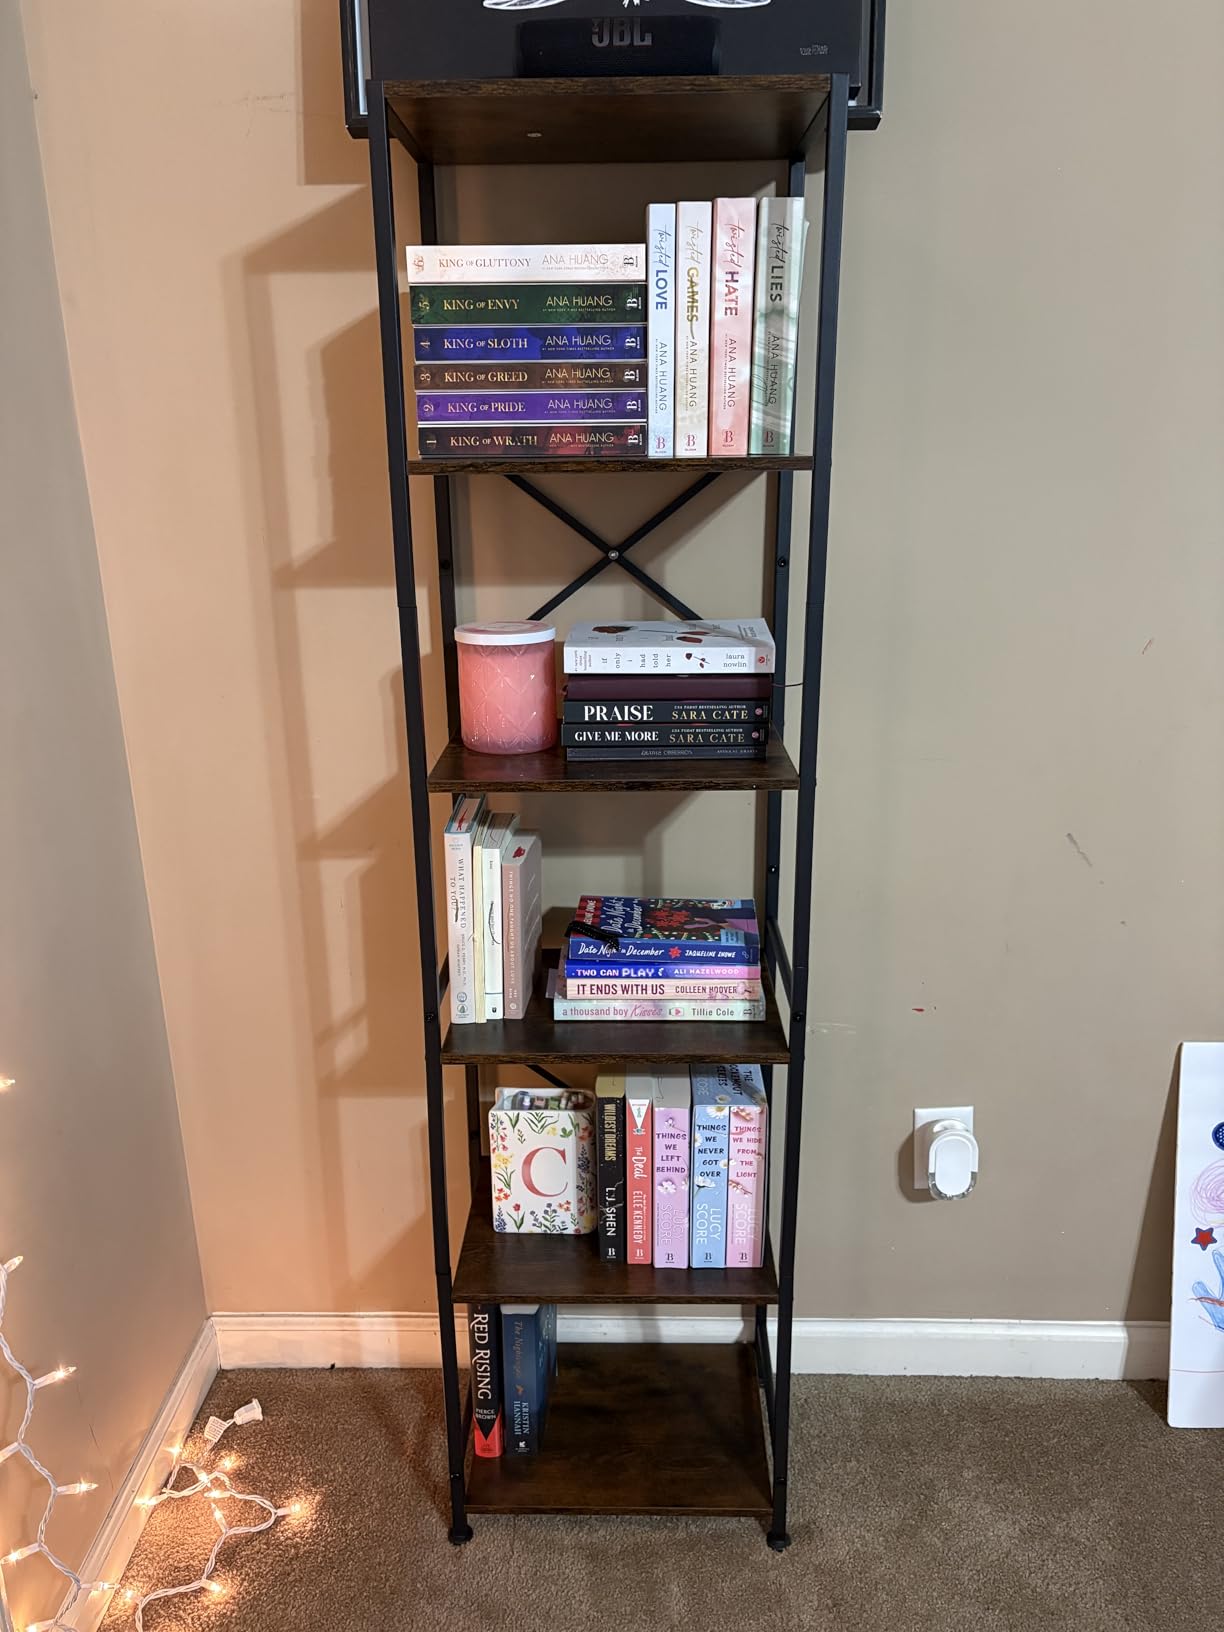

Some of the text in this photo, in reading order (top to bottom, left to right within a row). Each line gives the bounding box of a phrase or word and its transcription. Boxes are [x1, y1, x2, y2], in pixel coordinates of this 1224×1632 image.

[592, 18, 653, 47] JBL
[439, 258, 464, 268] KING
[475, 257, 531, 268] GLUTTONY
[542, 253, 609, 265] ANA HUANG
[769, 219, 790, 303] twisted LIES
[652, 223, 672, 310] twisted LOVE
[723, 219, 745, 316] twisted HATE
[546, 295, 613, 306] ANA HUANG
[686, 267, 699, 322] GAMES
[443, 300, 474, 310] KING
[487, 299, 520, 310] ENVY
[419, 341, 431, 350] 4
[444, 338, 473, 349] KING
[487, 337, 528, 348] SLOTH
[545, 334, 611, 345] ANA HUANG
[769, 335, 780, 360] ANA
[420, 373, 431, 381] 3
[444, 372, 474, 382] KING
[488, 371, 528, 382] GREED
[545, 367, 611, 378] ANA HUANG
[658, 341, 668, 411] ANA HUANG
[688, 340, 698, 408] ANA HUANG
[727, 338, 737, 408] ANA HUANG
[768, 364, 778, 405] HUANG
[423, 404, 434, 412] 2
[447, 402, 477, 413] KING
[491, 401, 526, 412] PRIDE
[547, 398, 613, 409] ANA HUANG
[450, 436, 480, 446] KING
[493, 435, 538, 446] WRATH
[549, 432, 614, 443] ANA HUANG
[614, 652, 622, 669] only
[723, 660, 747, 668] nowlin
[583, 705, 654, 721] PRAISE
[671, 710, 749, 720] SARA CATE
[574, 731, 659, 741] GIVE ME MORE
[669, 733, 745, 743] SARA CATE
[450, 876, 456, 888] TO
[458, 885, 467, 929] HAPPENED
[600, 917, 623, 933] Date
[578, 942, 598, 955] Date
[626, 945, 665, 956] December
[685, 949, 717, 958] JAQUELINE
[576, 967, 655, 977] TWO CAN PLAY
[577, 984, 665, 995] IT ENDS WITH US
[675, 985, 737, 994] COLLEEN HOOVER
[562, 1004, 663, 1018] a thousand boy Kisses
[692, 1008, 735, 1016] Tillie Cole
[743, 1070, 753, 1082] THE
[604, 1104, 617, 1162] WILDEST DREAMS
[734, 1125, 762, 1133] THINGS
[697, 1147, 725, 1155] NEVER
[631, 1146, 648, 1180] The Deal
[656, 1166, 686, 1174] BEHIND
[521, 1146, 568, 1198] C
[605, 1187, 617, 1236] L.J. SHEN
[633, 1190, 643, 1244] ELLE KENNEDY
[660, 1203, 673, 1246] SCORE
[672, 1209, 684, 1241] LUCY
[696, 1203, 708, 1245] SCORE
[709, 1208, 722, 1240] LUCY
[735, 1203, 748, 1245] SCORE
[747, 1208, 758, 1240] LUCY
[514, 1321, 523, 1336] The
[470, 1313, 492, 1400] RED RISING
[513, 1400, 522, 1436] HANNAH
[522, 1402, 530, 1435] KRISTIN
